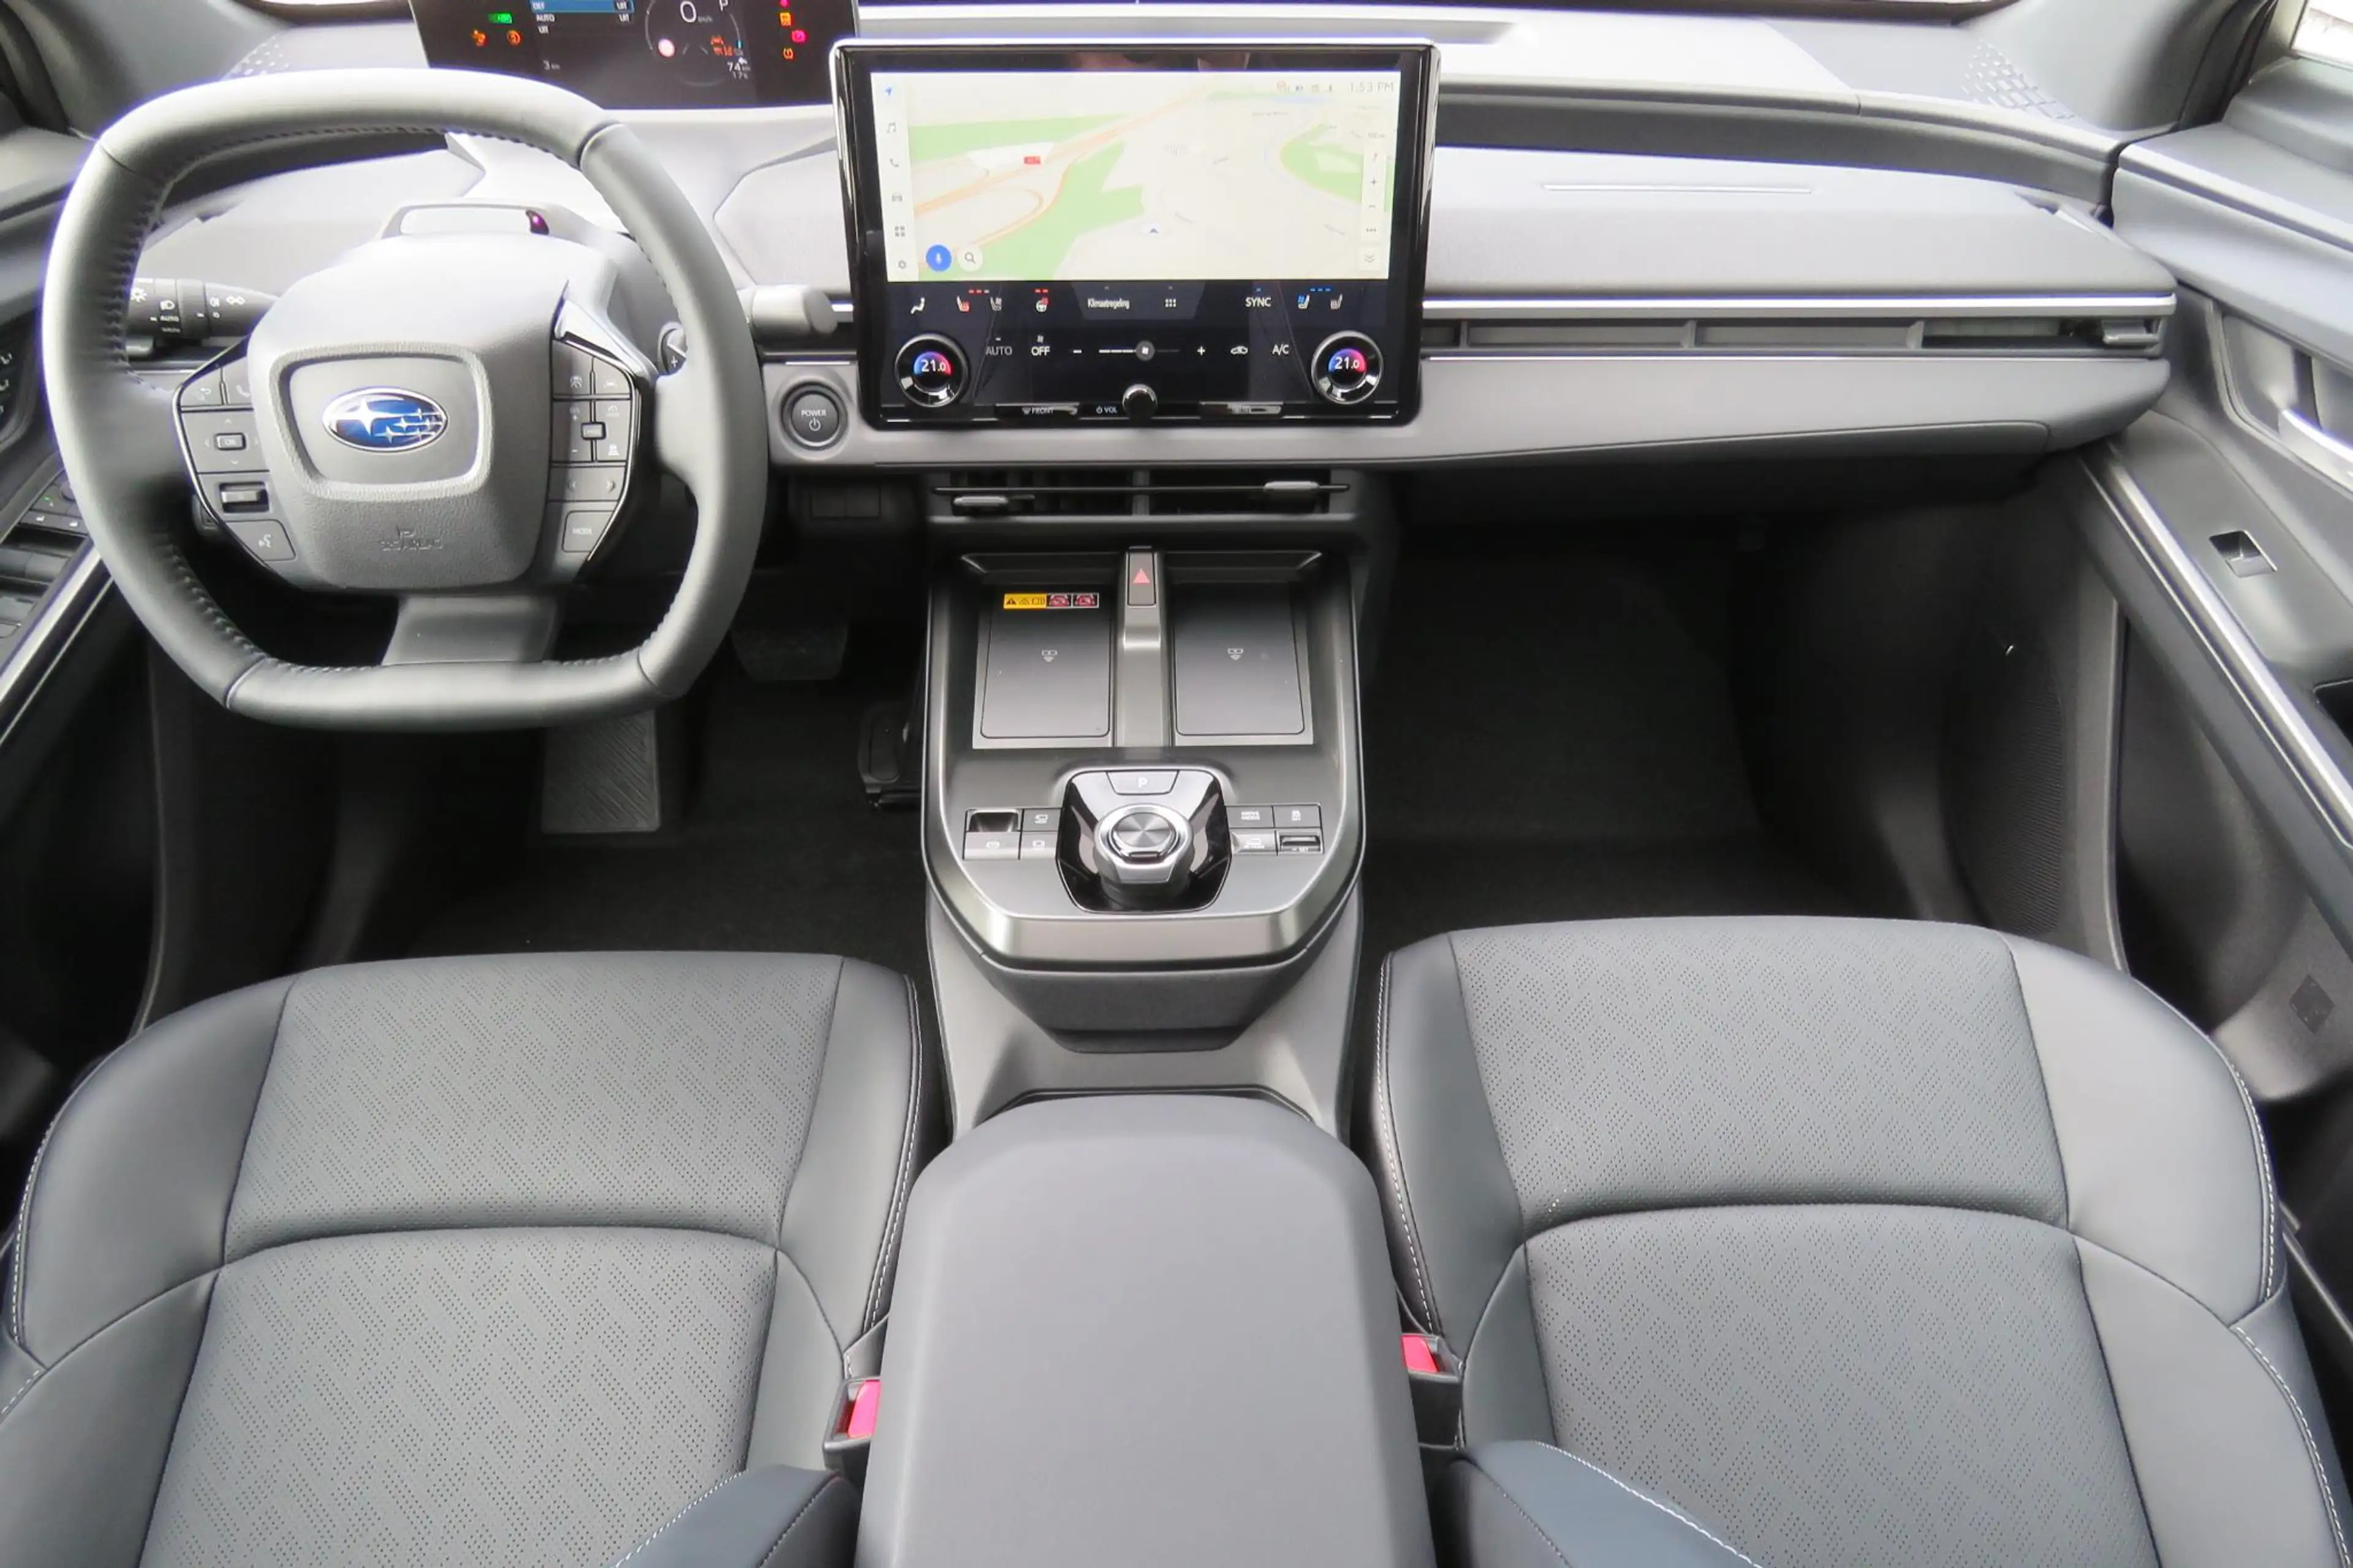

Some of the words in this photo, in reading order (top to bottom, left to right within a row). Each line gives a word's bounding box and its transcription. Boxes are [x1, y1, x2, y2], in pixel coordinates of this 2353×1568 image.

[680, 1, 697, 23] 0
[719, 0, 729, 11] P
[1245, 297, 1272, 307] SYNC
[986, 346, 1013, 356] AUTO
[1031, 346, 1051, 356] OFF
[1272, 343, 1290, 356] A/C
[921, 359, 947, 372] 21.0
[1334, 356, 1360, 370] 21.0
[1138, 776, 1148, 789] P
